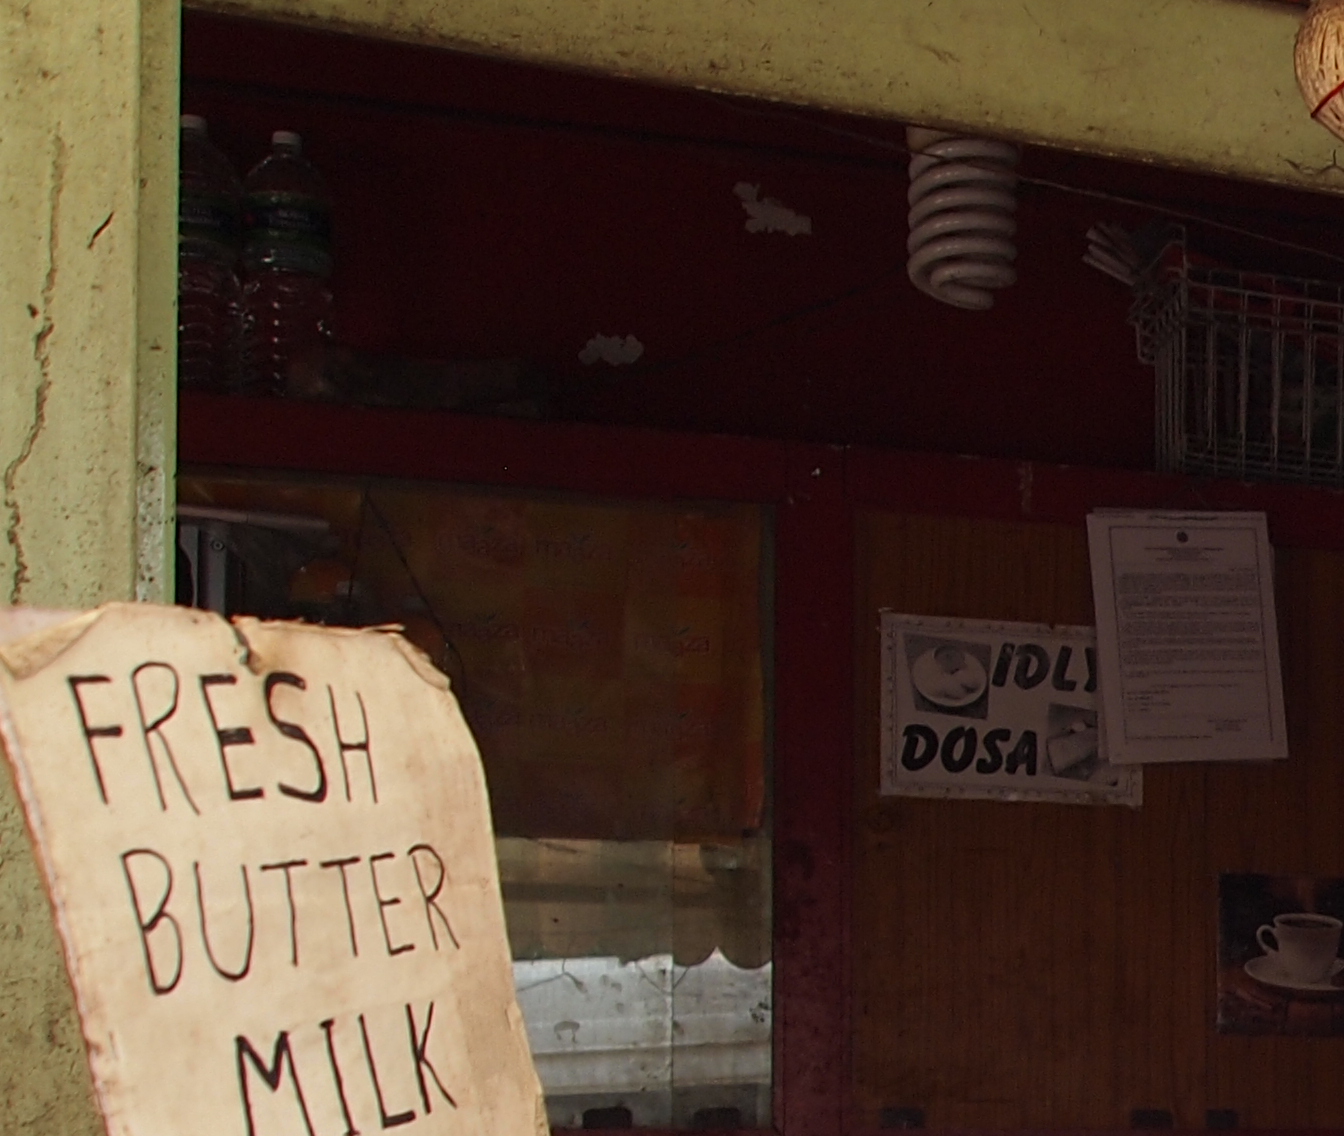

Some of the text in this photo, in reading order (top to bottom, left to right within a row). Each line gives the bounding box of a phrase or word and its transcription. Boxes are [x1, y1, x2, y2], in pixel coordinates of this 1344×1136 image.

[67, 661, 381, 815] FRESH
[900, 723, 1039, 777] DOSA
[121, 844, 461, 996] BUTTER
